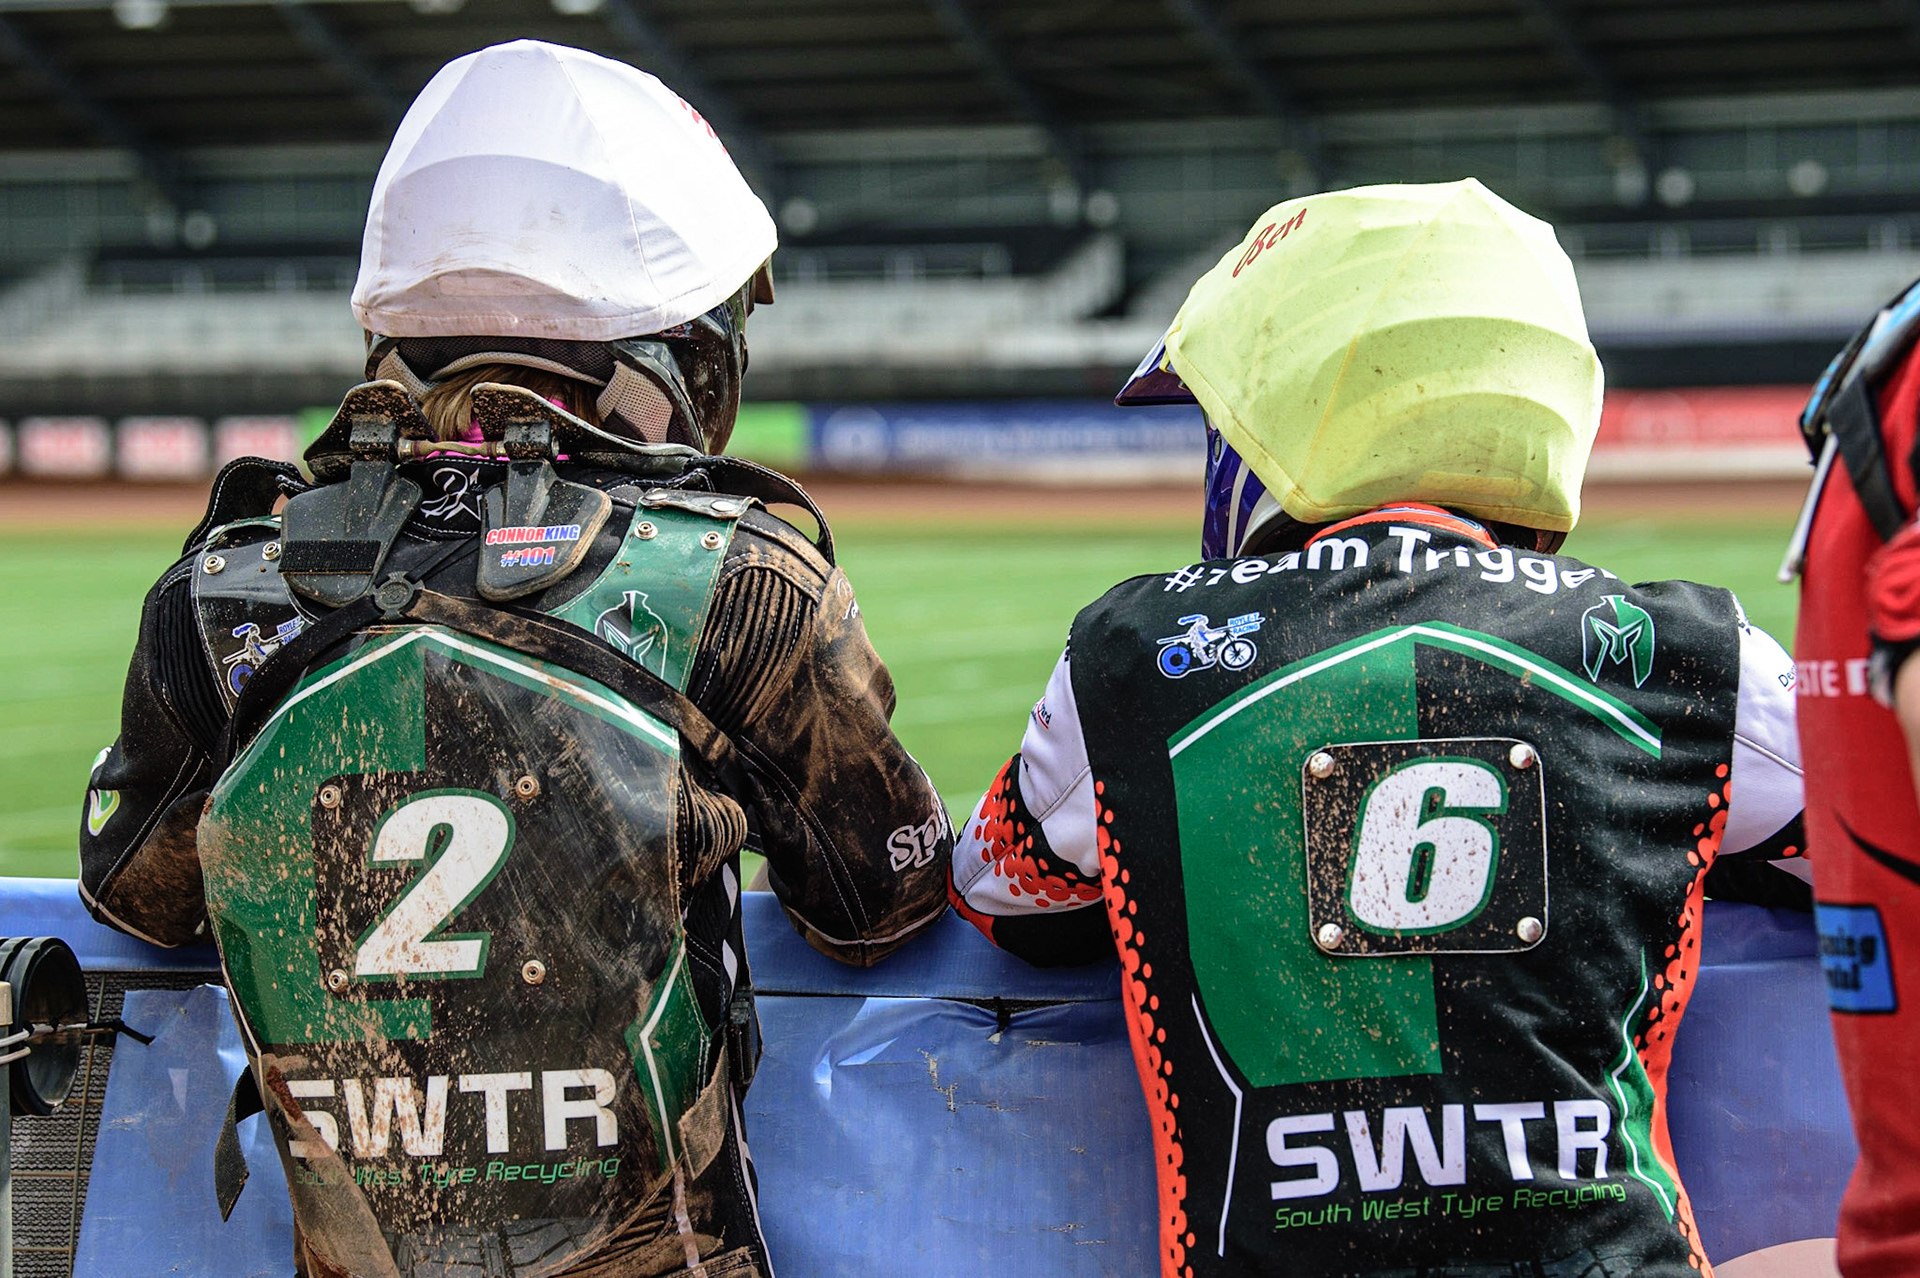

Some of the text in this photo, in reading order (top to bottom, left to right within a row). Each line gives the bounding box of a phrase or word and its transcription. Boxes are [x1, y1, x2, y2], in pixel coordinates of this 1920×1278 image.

[1232, 207, 1307, 278] Ben
[486, 525, 580, 545] CONNORKING
[500, 546, 556, 567] #101
[1232, 623, 1259, 635] RACING
[1344, 755, 1509, 936] 6
[354, 788, 516, 984] 2
[286, 1067, 619, 1159] SWTR
[485, 1156, 620, 1185] Recycling
[1265, 1099, 1611, 1200] SWTR
[1274, 1182, 1626, 1229] South West Tyre Recycling
